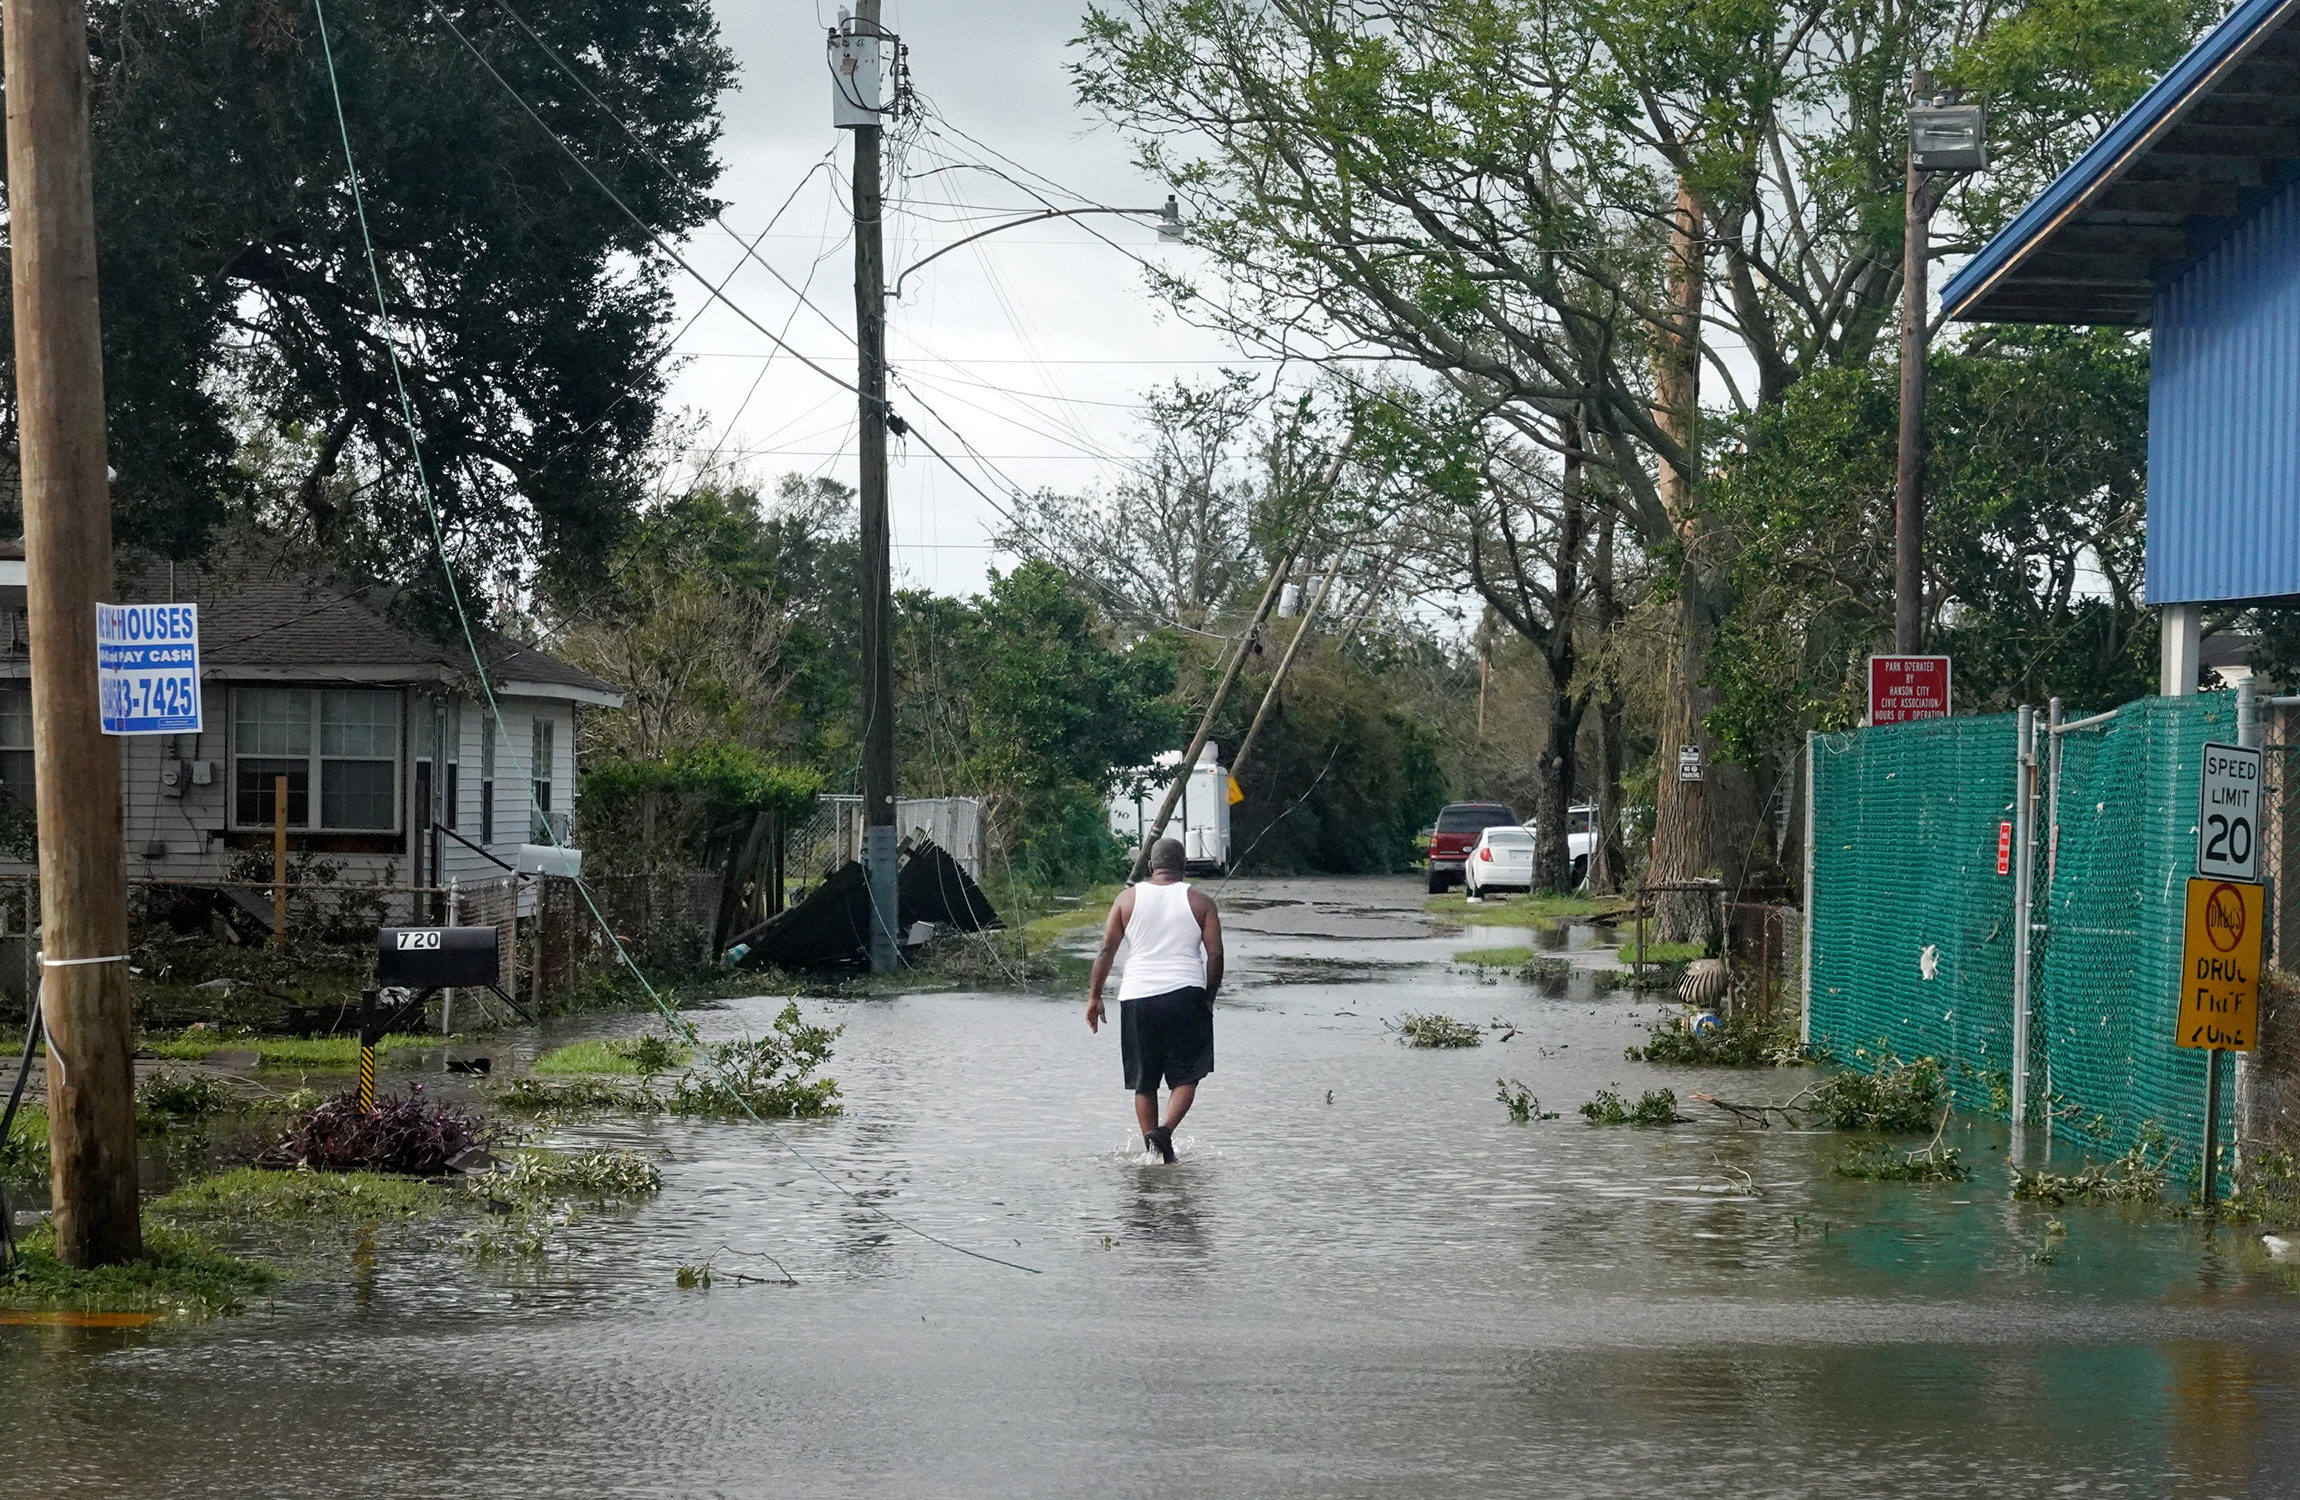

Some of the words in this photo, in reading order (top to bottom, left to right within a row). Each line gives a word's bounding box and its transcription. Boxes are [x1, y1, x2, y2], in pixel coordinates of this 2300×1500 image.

[119, 650, 144, 662] PAY
[149, 649, 192, 663] CA$H
[1886, 662, 1901, 671] PARK
[1904, 662, 1934, 671] OPERATED
[1906, 674, 1914, 683] BY
[1890, 686, 1913, 696] HANSON
[1916, 686, 1929, 696] CITY
[1881, 698, 1897, 708] CIVIC
[1901, 698, 1938, 708] ASSOCIATION
[1874, 710, 1894, 720] HOURS
[1897, 710, 1905, 720] OF
[2208, 757, 2256, 780] SPEED
[2211, 787, 2250, 808] LIMIT
[2206, 814, 2251, 864] 20
[399, 932, 439, 948] 720
